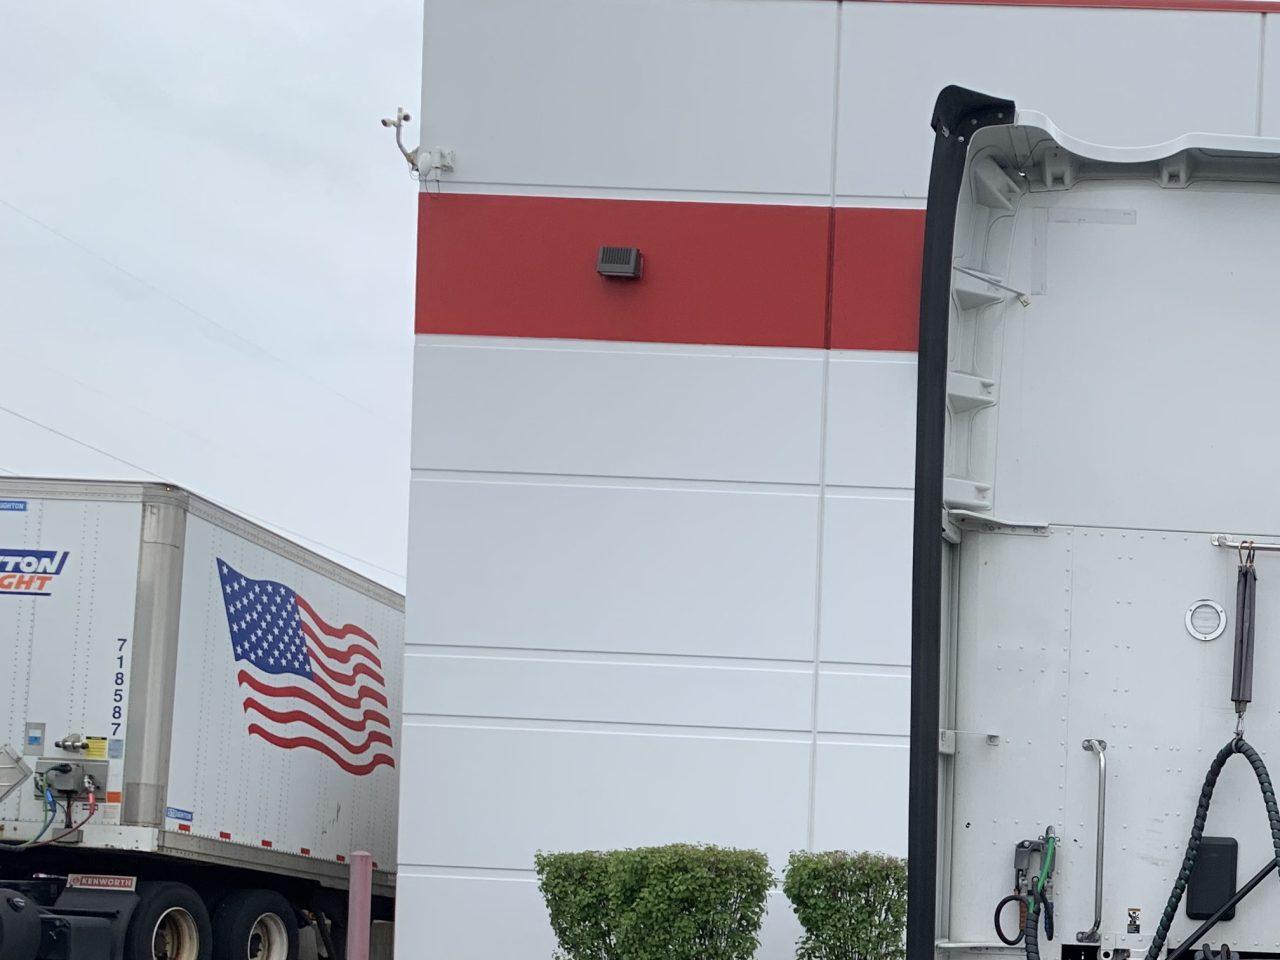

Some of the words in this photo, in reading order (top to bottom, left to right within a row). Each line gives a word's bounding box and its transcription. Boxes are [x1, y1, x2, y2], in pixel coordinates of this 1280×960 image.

[0, 555, 60, 573] TON
[111, 638, 127, 736] 718587
[81, 877, 132, 886] KENWORTH
